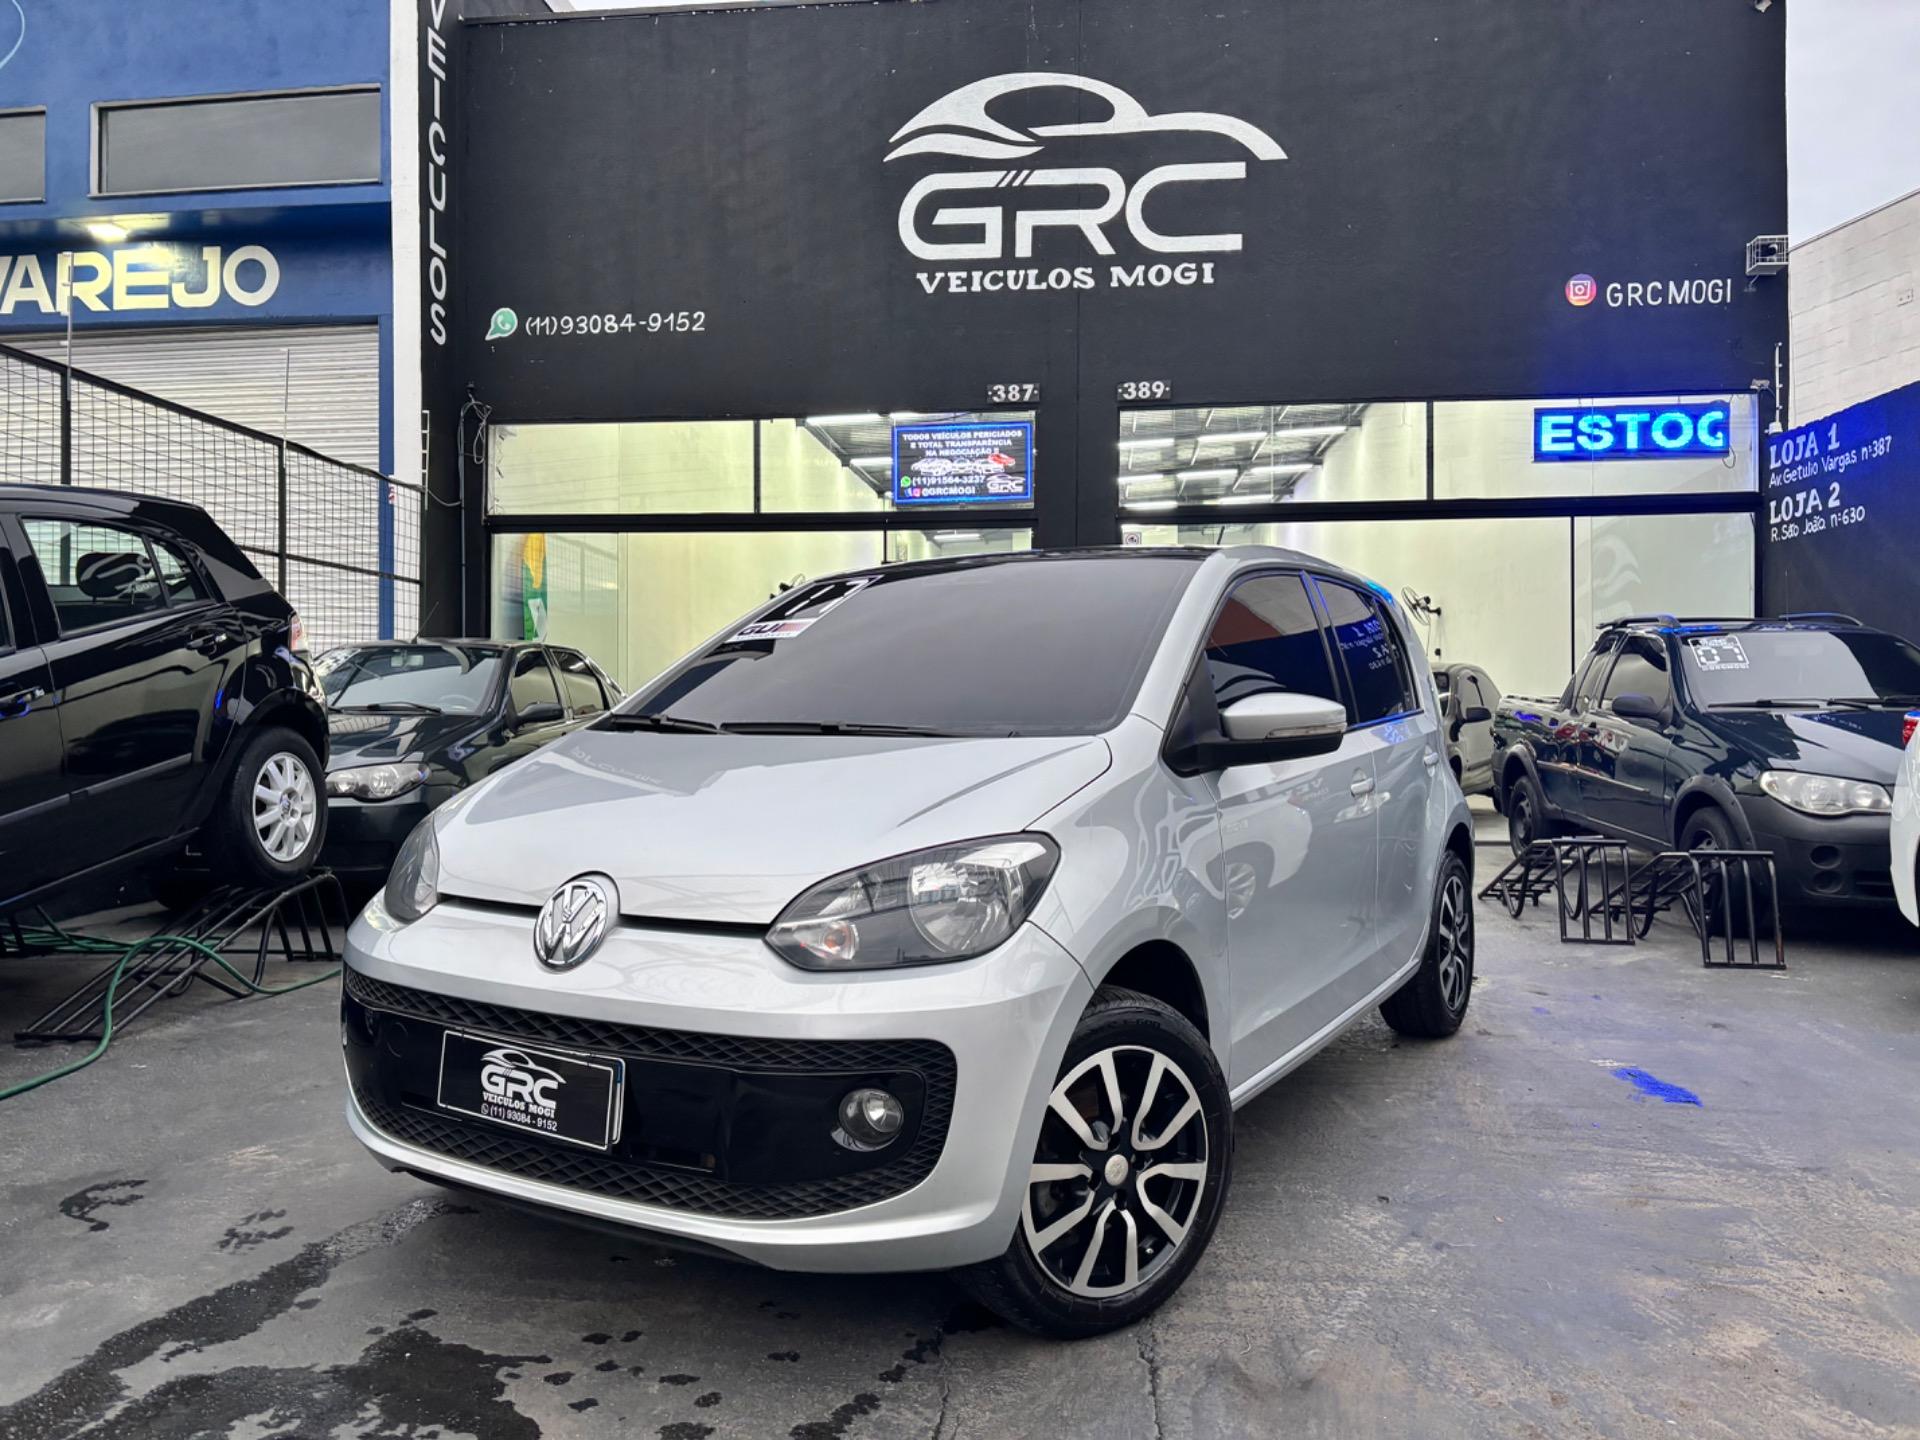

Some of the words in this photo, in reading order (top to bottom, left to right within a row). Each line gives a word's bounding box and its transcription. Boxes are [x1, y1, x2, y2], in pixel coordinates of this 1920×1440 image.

[898, 161, 1246, 260] GRC
[916, 266, 1095, 294] VEICULOS
[1110, 262, 1215, 288] MOGI
[525, 311, 705, 336] (11)93084-9152
[1769, 431, 1819, 470] LOJA
[1827, 422, 1840, 451] 1
[1769, 488, 1823, 525] LOJA
[1827, 482, 1840, 508] 2
[481, 1064, 558, 1110] GRC
[482, 1091, 525, 1110] VEICULOS
[528, 1104, 555, 1118] MOGI
